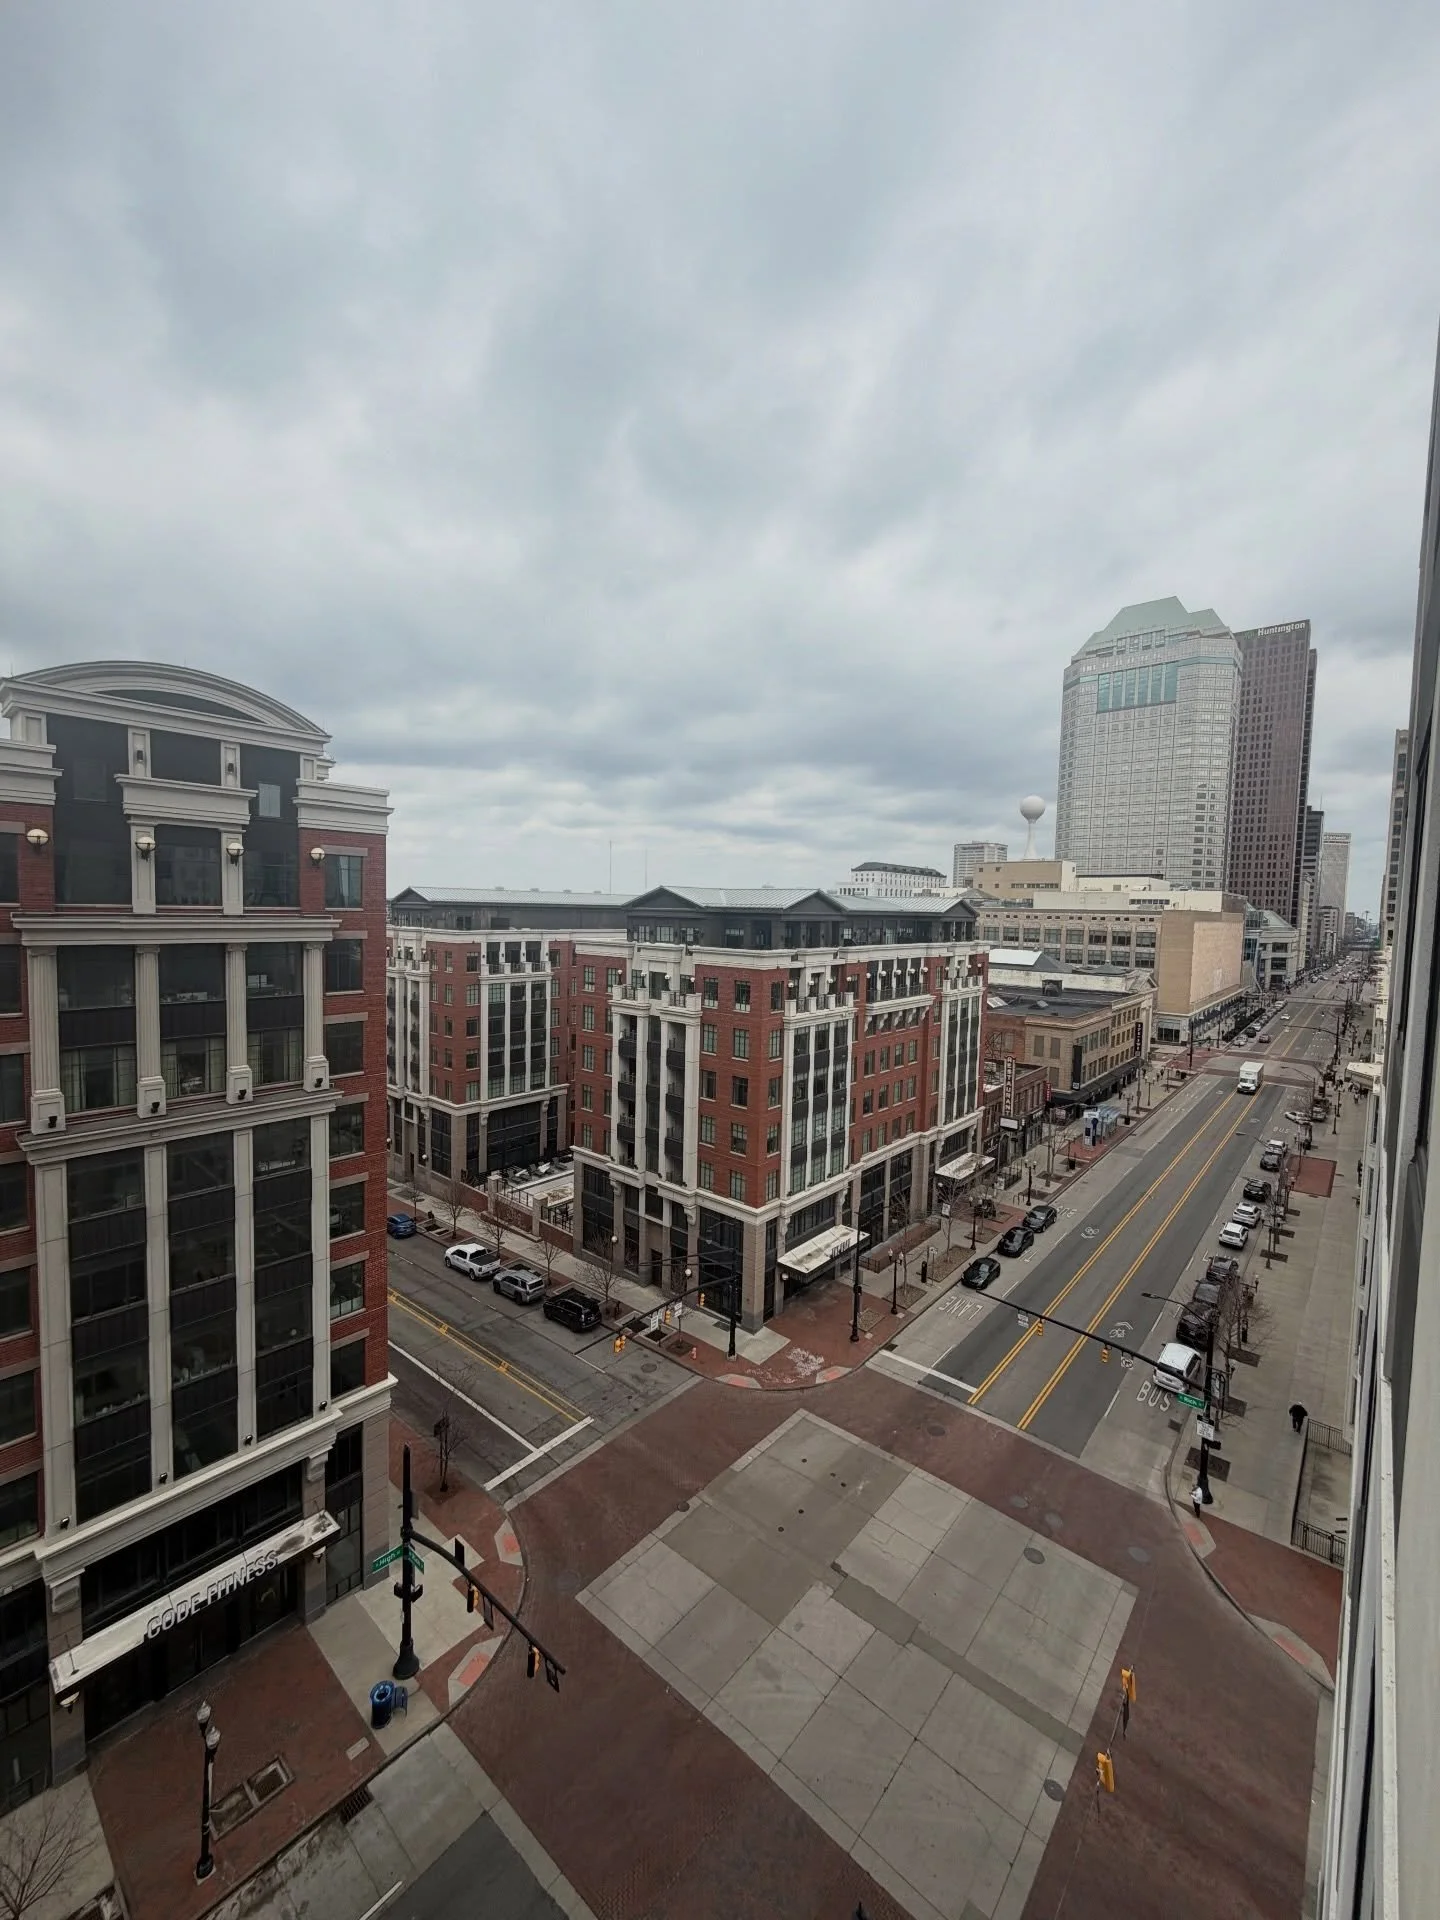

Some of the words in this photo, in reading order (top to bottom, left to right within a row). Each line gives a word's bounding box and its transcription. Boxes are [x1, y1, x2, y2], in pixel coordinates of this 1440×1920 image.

[1257, 622, 1305, 636] Huntington
[1005, 1056, 1013, 1115] RESTAURANT
[938, 1295, 983, 1320] LANE
[1136, 1380, 1171, 1412] BUS
[379, 1552, 396, 1566] High
[147, 1592, 201, 1639] CODE
[206, 1549, 279, 1606] FITNESS
